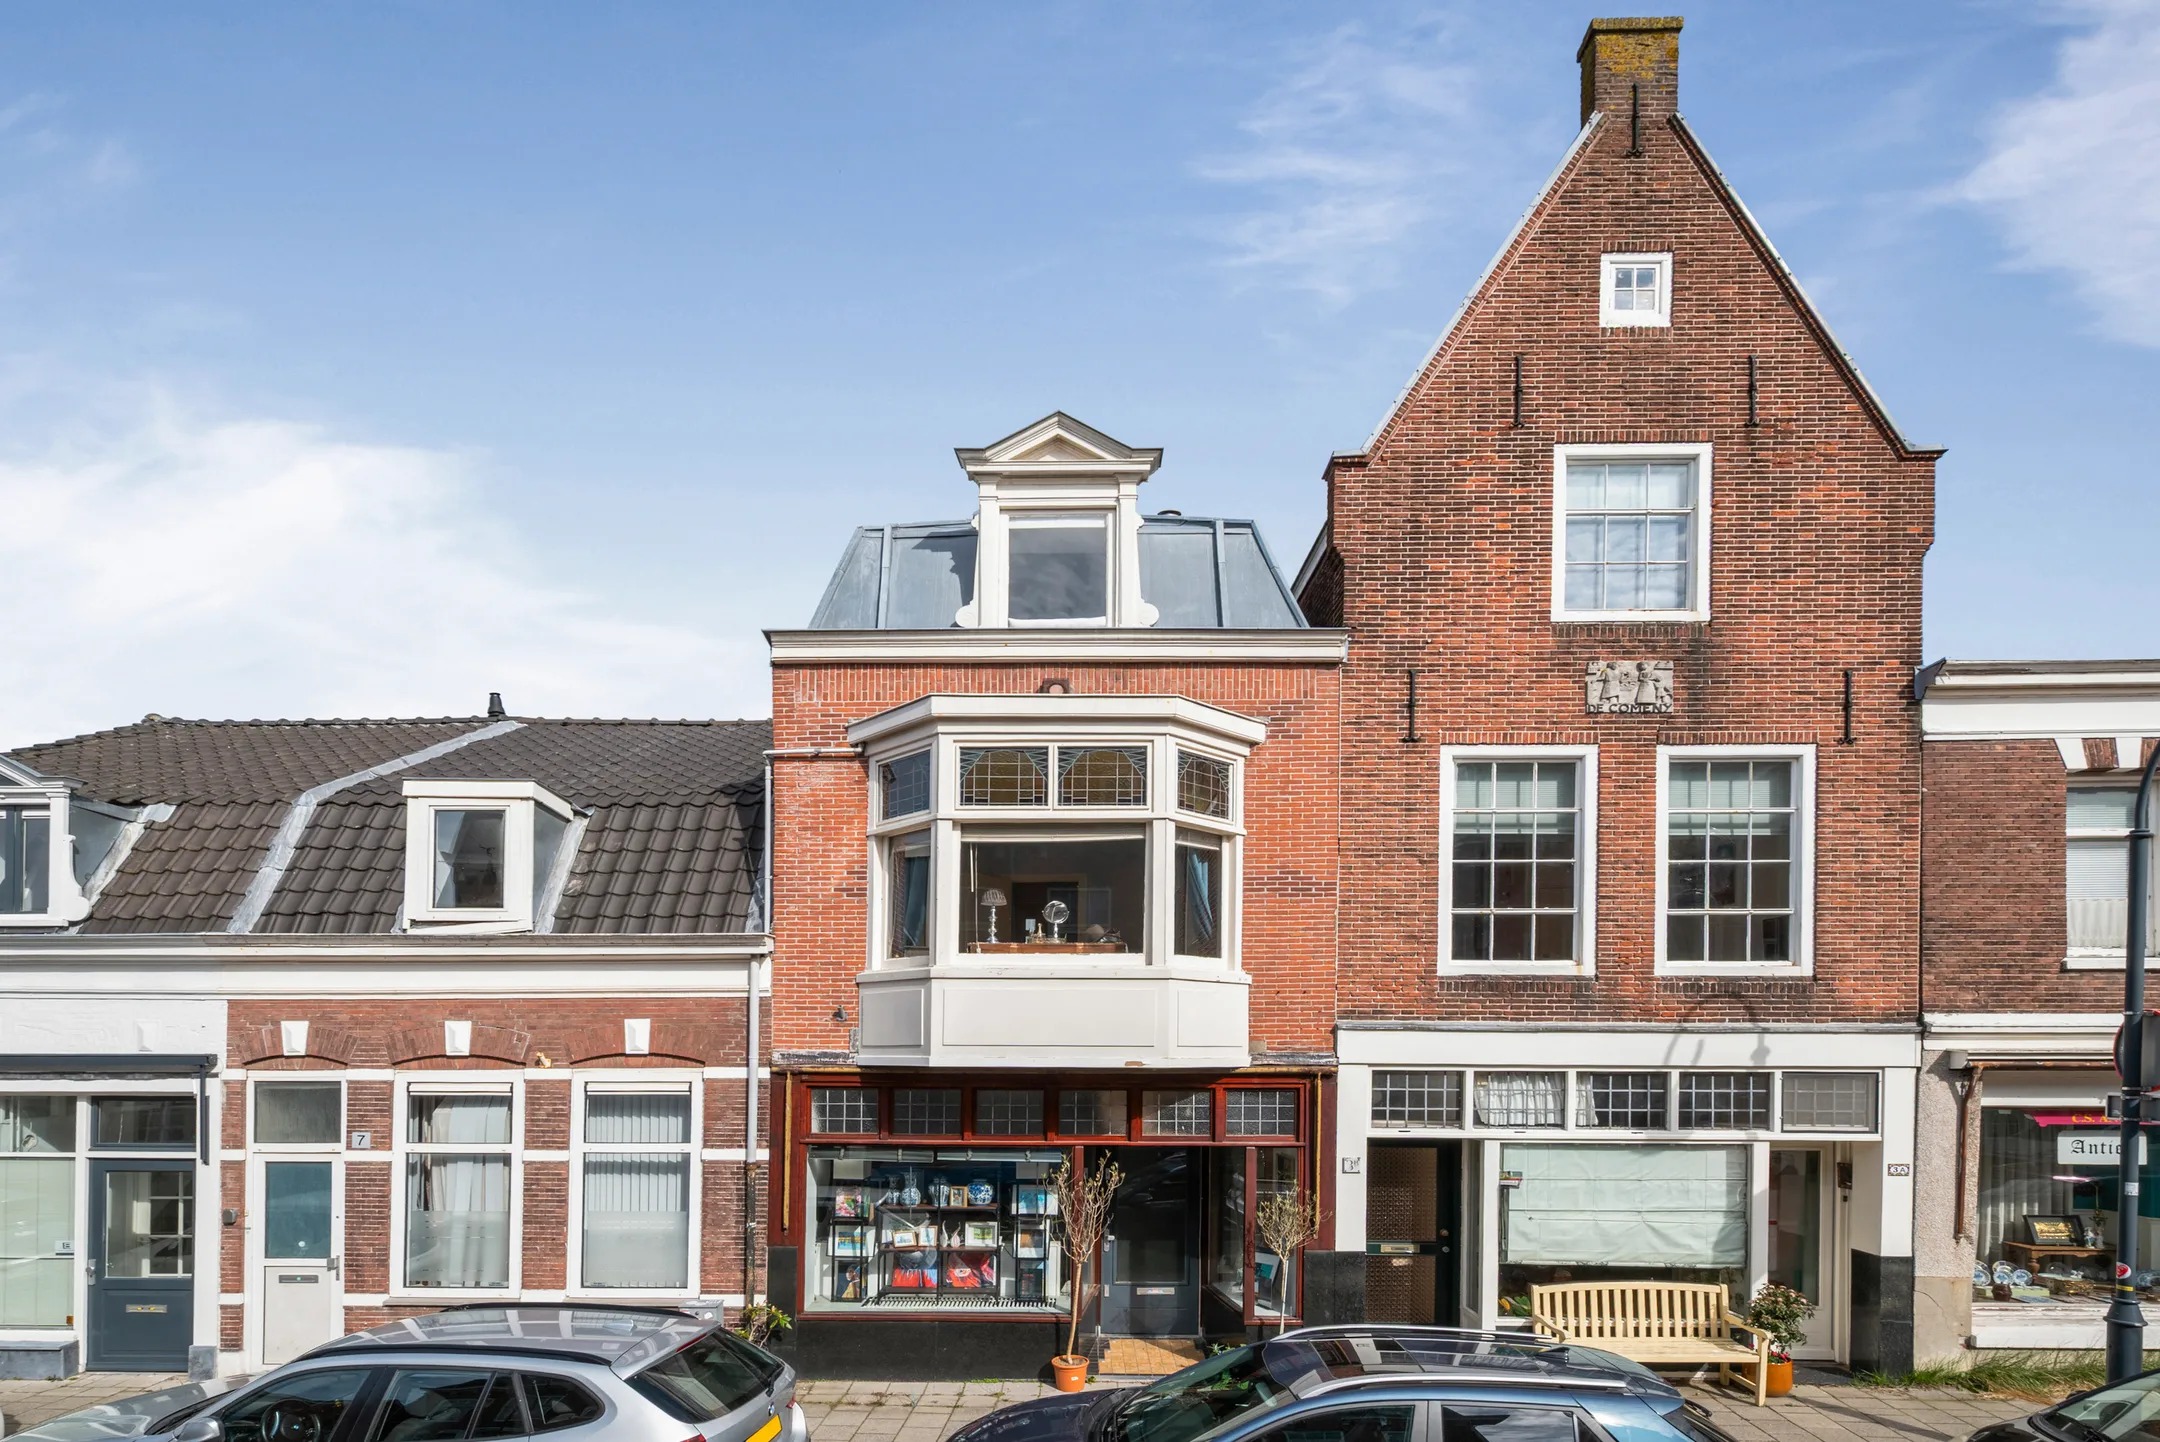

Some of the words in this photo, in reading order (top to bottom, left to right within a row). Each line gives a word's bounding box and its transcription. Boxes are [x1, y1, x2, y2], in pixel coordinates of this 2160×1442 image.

[1587, 703, 1604, 713] DE
[1608, 703, 1672, 713] COMENY
[357, 1134, 366, 1146] 7
